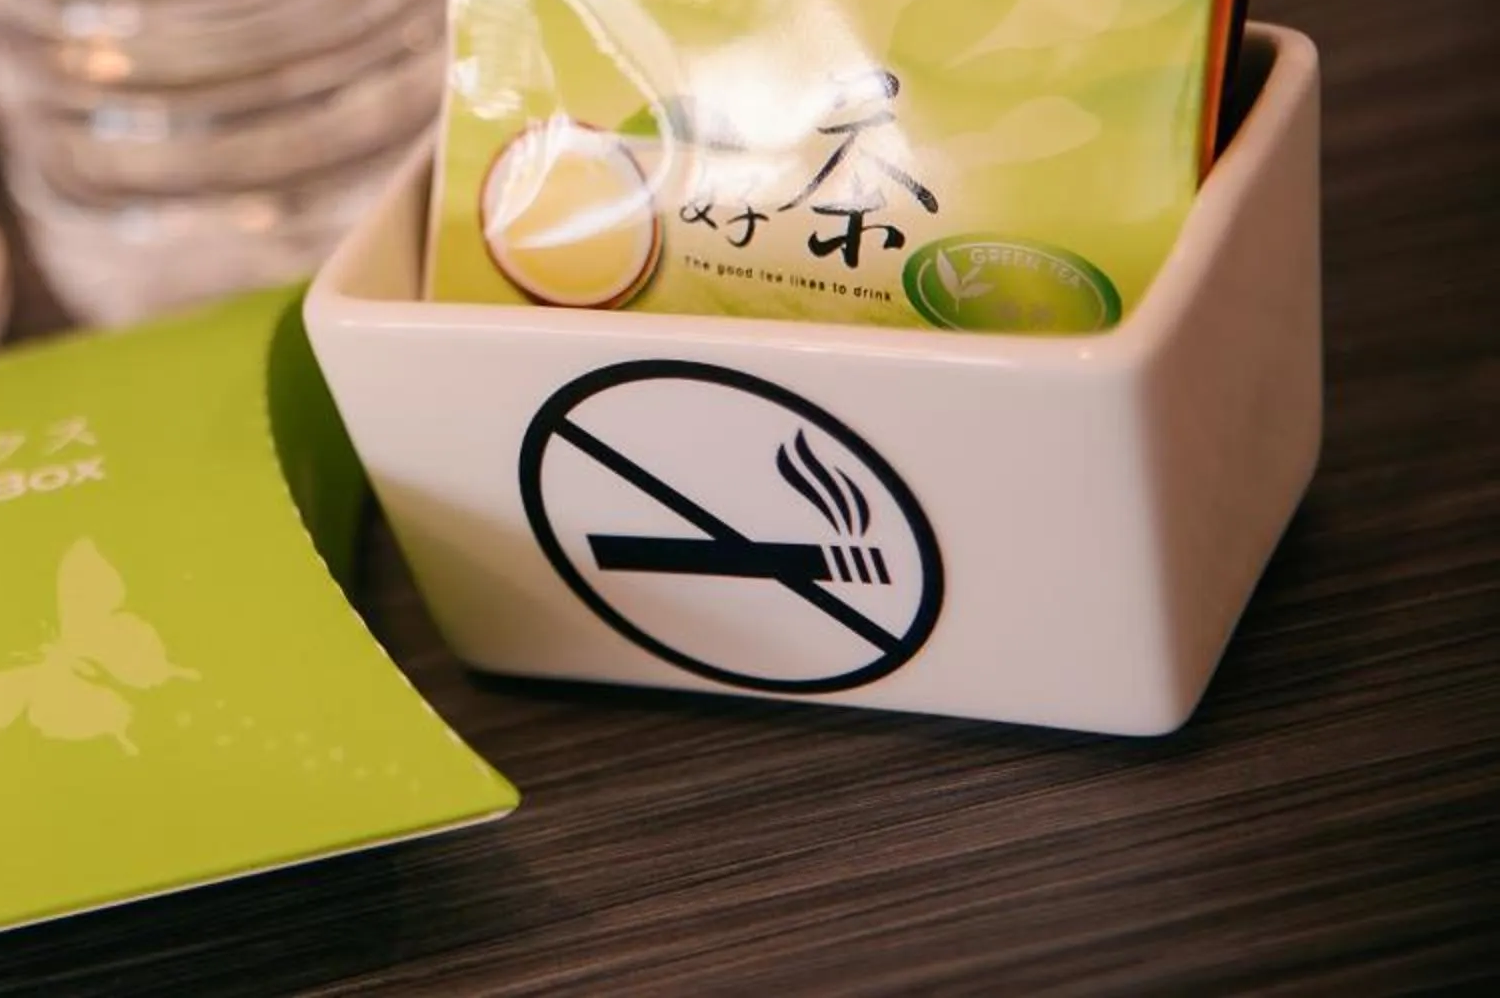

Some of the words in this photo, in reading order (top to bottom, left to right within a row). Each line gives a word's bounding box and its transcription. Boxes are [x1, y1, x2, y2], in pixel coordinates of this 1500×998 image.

[717, 264, 754, 278] good
[832, 282, 847, 295] to
[853, 285, 891, 301] drink
